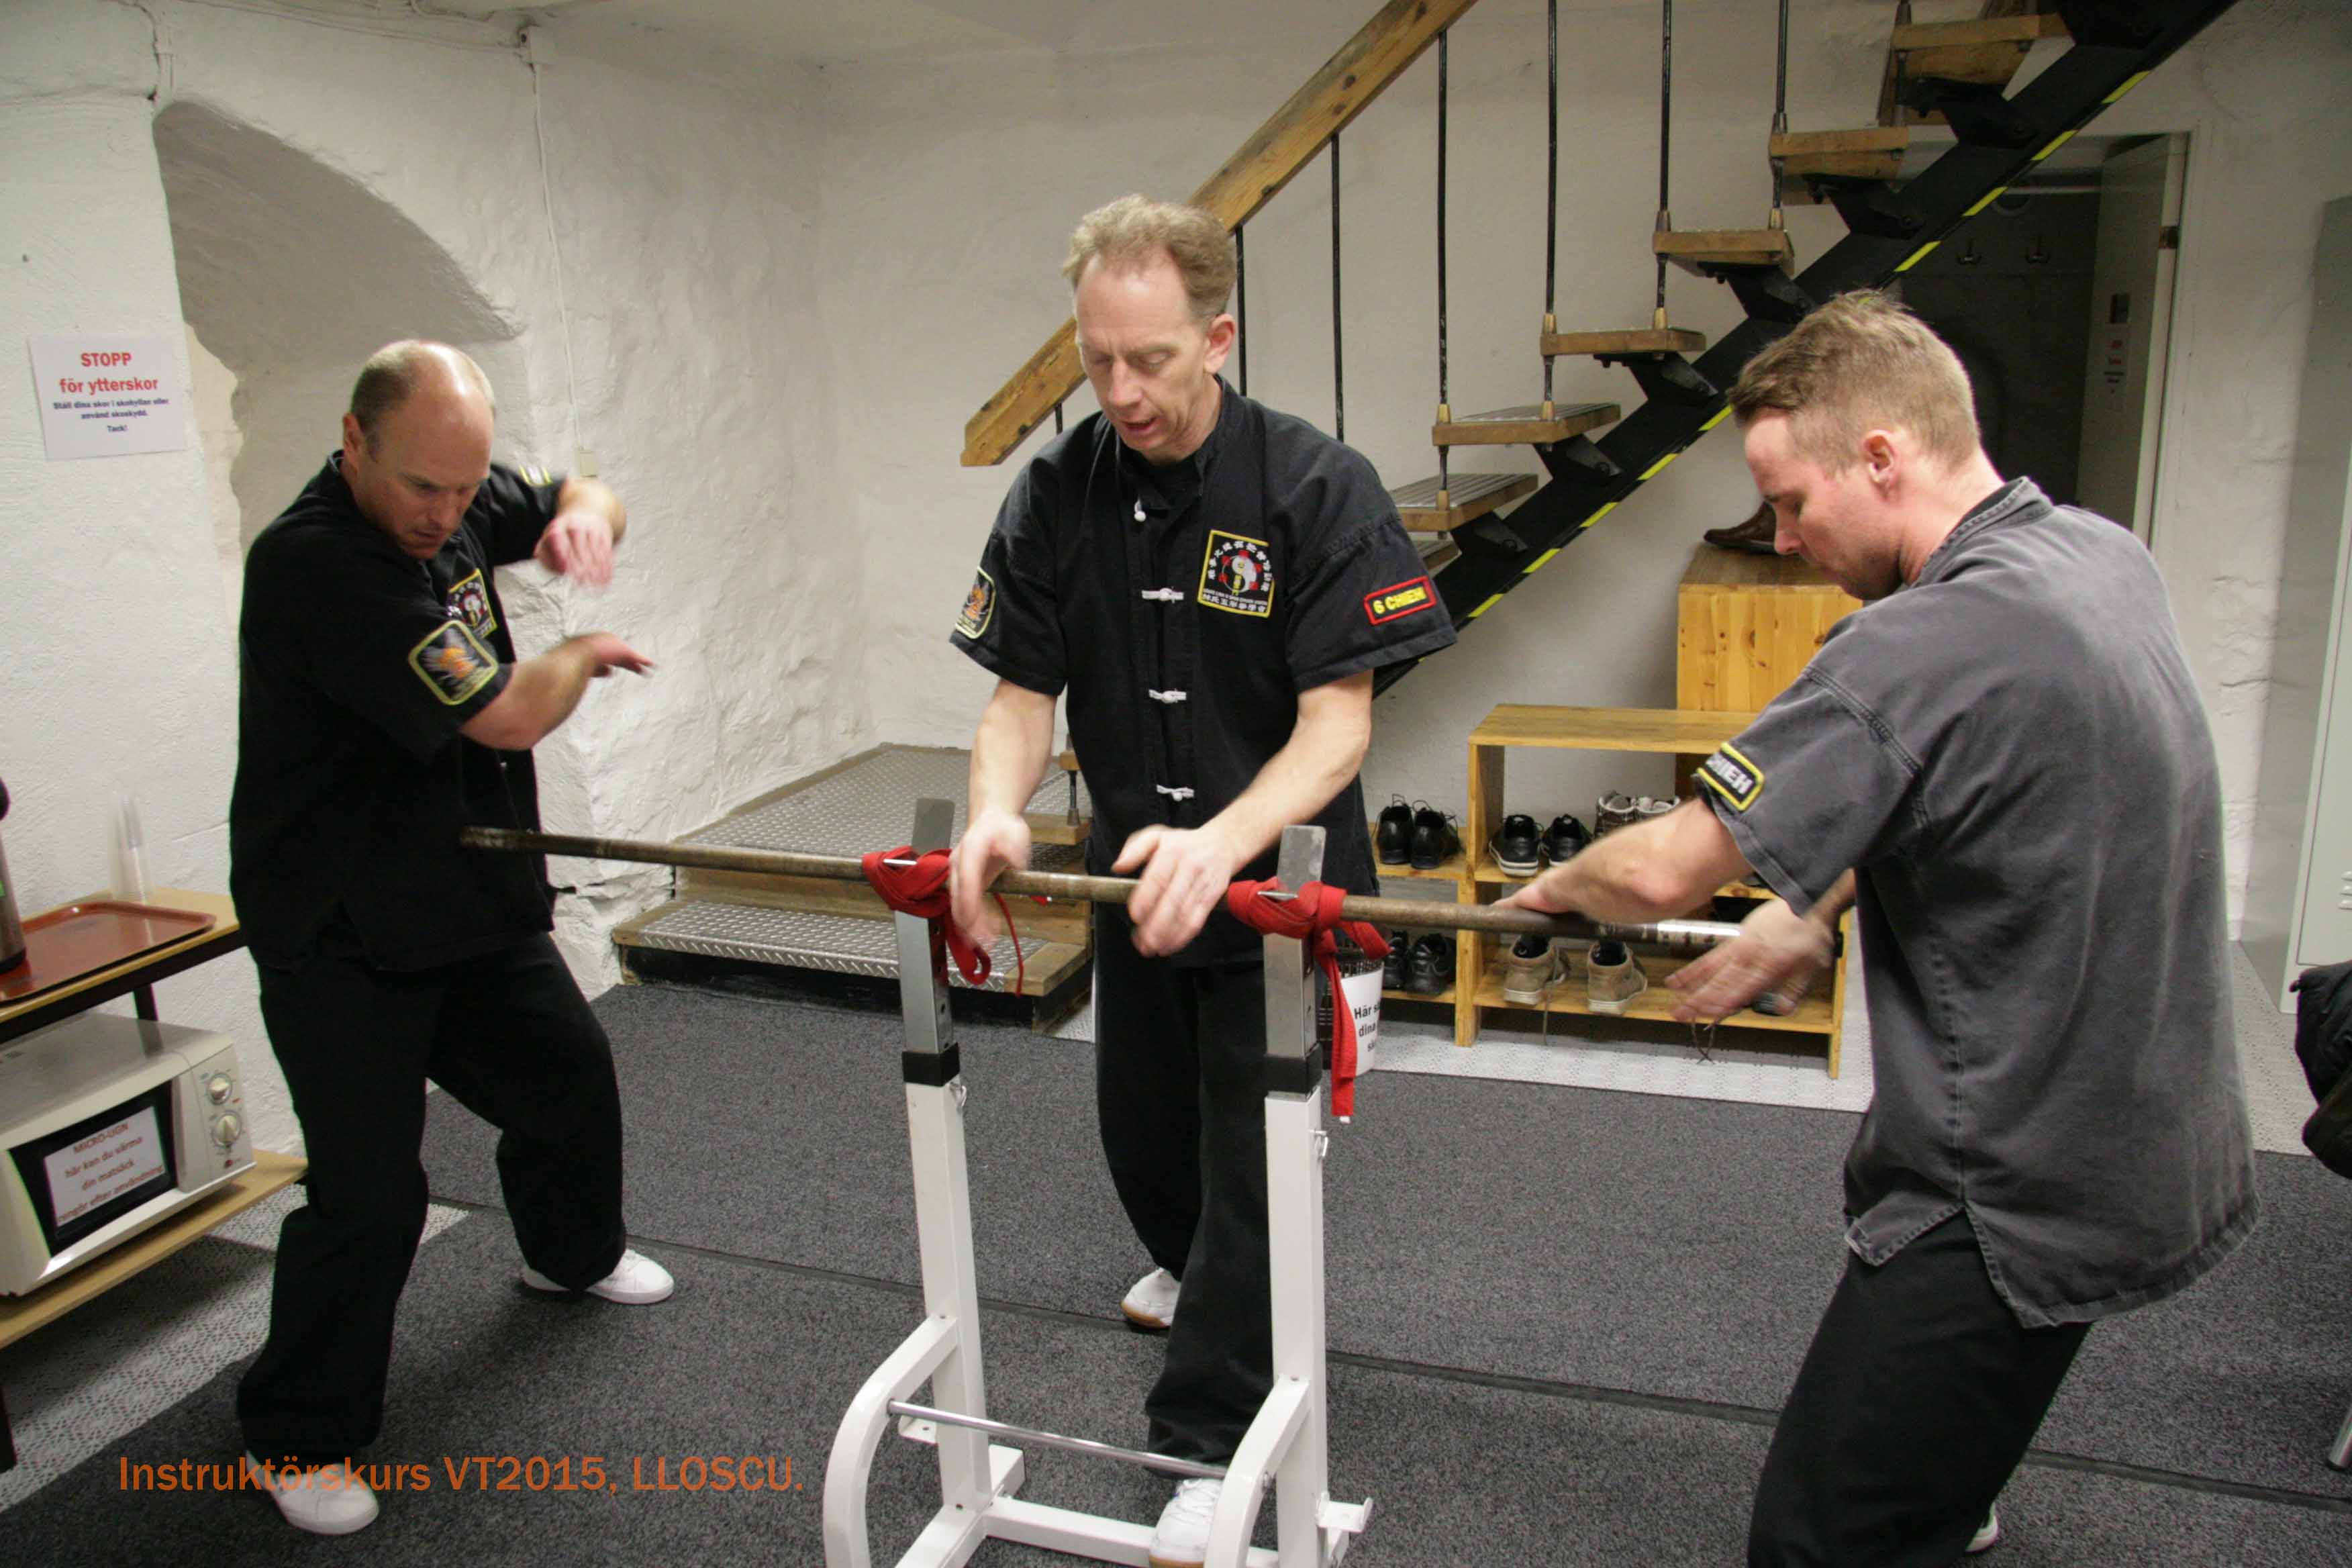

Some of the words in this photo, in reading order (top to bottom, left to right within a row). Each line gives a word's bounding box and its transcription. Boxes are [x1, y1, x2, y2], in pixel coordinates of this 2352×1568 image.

[81, 352, 132, 366] STOPP
[60, 378, 83, 393] för
[88, 377, 158, 395] ytterskor
[1373, 599, 1385, 614] 6
[1354, 1004, 1371, 1019] Här
[1359, 1023, 1376, 1037] dina
